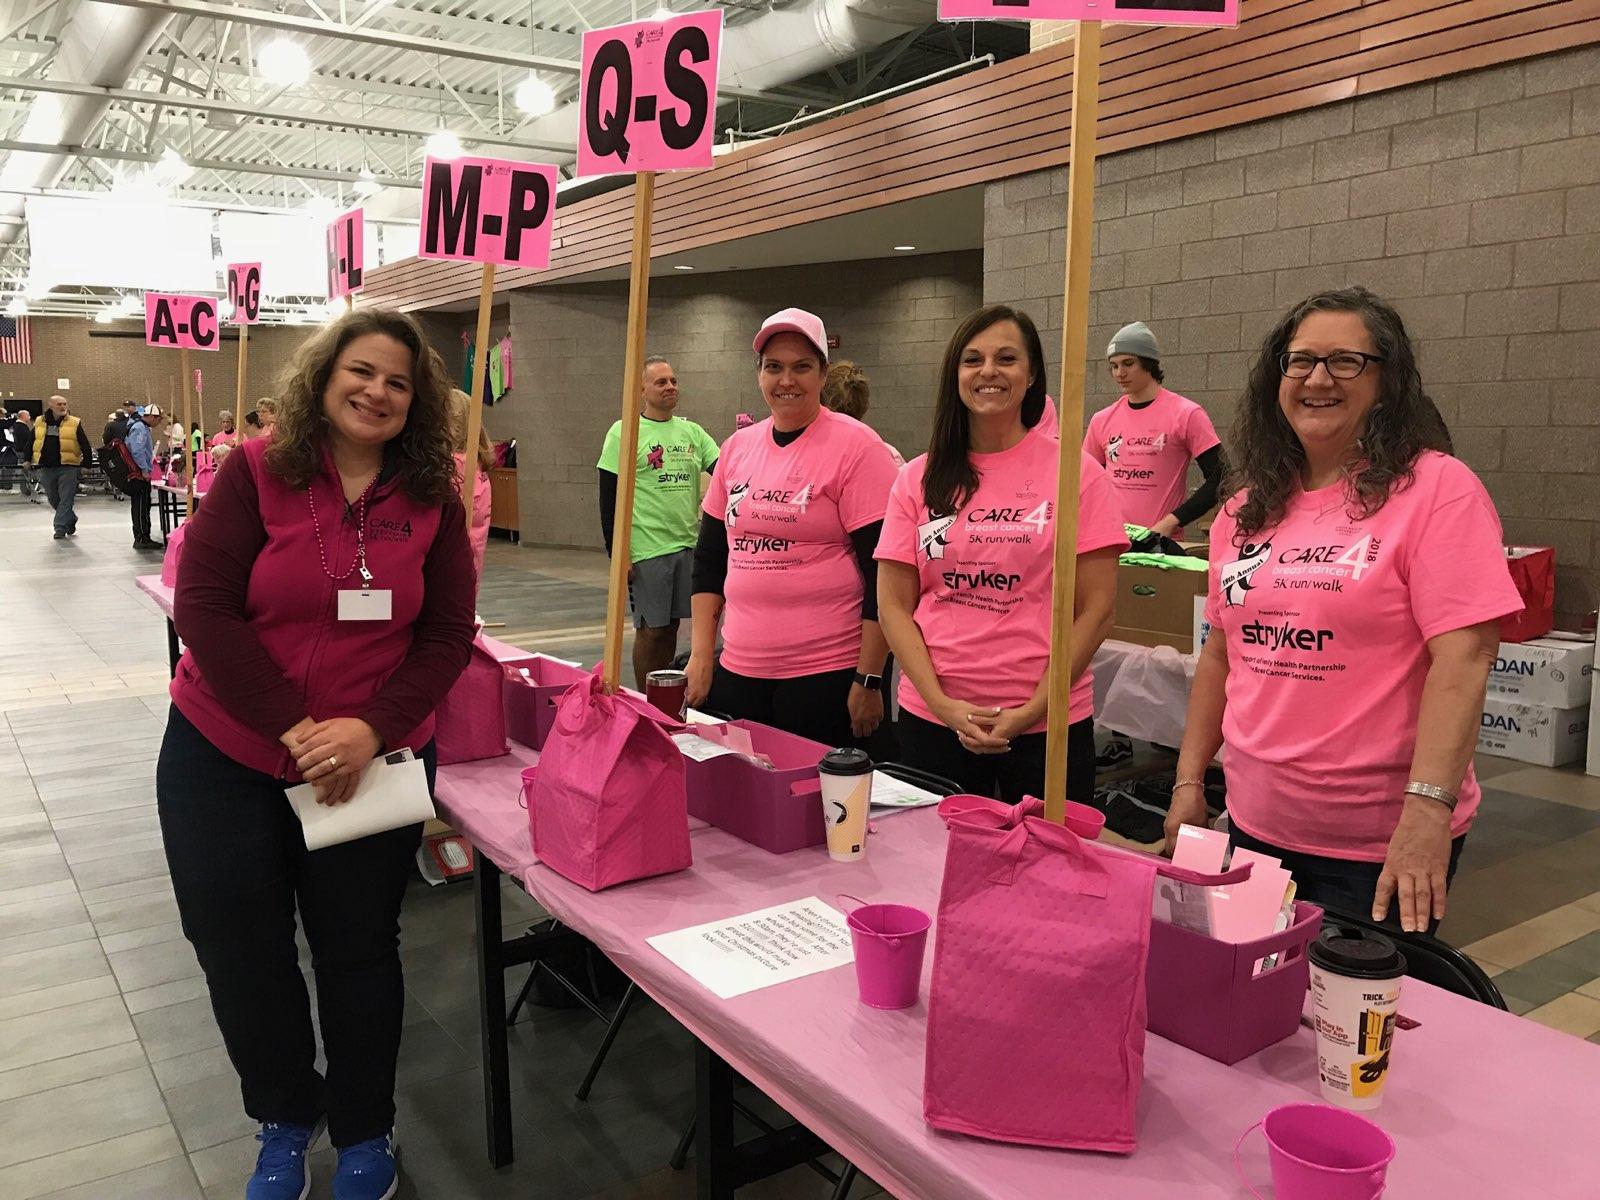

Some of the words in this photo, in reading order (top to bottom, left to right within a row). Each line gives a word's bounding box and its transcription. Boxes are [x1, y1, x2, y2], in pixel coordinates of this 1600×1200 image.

[586, 26, 710, 164] Q-S
[425, 163, 549, 261] M-P
[151, 299, 215, 347] A-C
[658, 472, 691, 483] stryker
[1114, 469, 1155, 480] stryker
[752, 489, 793, 503] CARE
[968, 508, 1027, 523] CARE
[369, 519, 401, 531] CARE
[401, 521, 413, 538] 4
[733, 535, 796, 554] stryker
[1367, 537, 1382, 562] 2018
[1278, 545, 1345, 564] CARE
[1335, 534, 1370, 580] 4
[1237, 559, 1264, 578] Annual
[1309, 566, 1352, 577] cancer
[1273, 579, 1287, 589] 5K
[1289, 579, 1343, 592] run/walk
[1241, 619, 1334, 651] stryker
[1274, 660, 1298, 669] Health
[1298, 662, 1346, 673] Partnership
